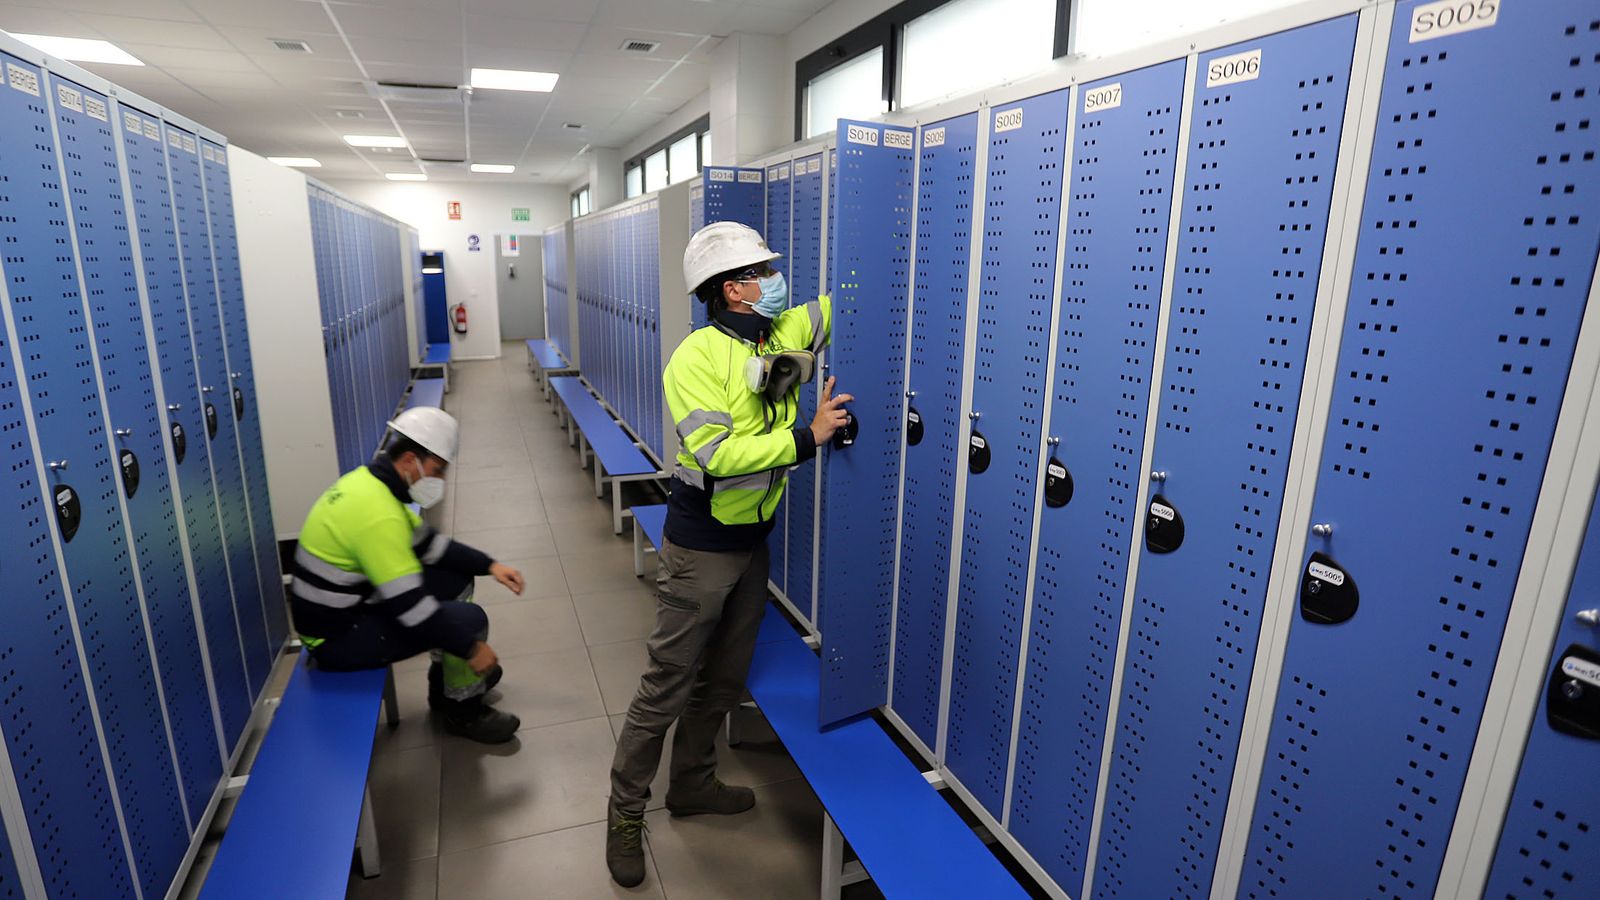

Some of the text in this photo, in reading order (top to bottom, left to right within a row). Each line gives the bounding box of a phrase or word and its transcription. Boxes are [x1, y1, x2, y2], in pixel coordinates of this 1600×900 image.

[1414, 0, 1496, 34] S005
[1209, 56, 1259, 81] S006
[1086, 88, 1120, 108] S007
[996, 112, 1022, 129] S008
[849, 128, 878, 143] S010
[925, 131, 945, 145] S009
[711, 171, 733, 180] S014
